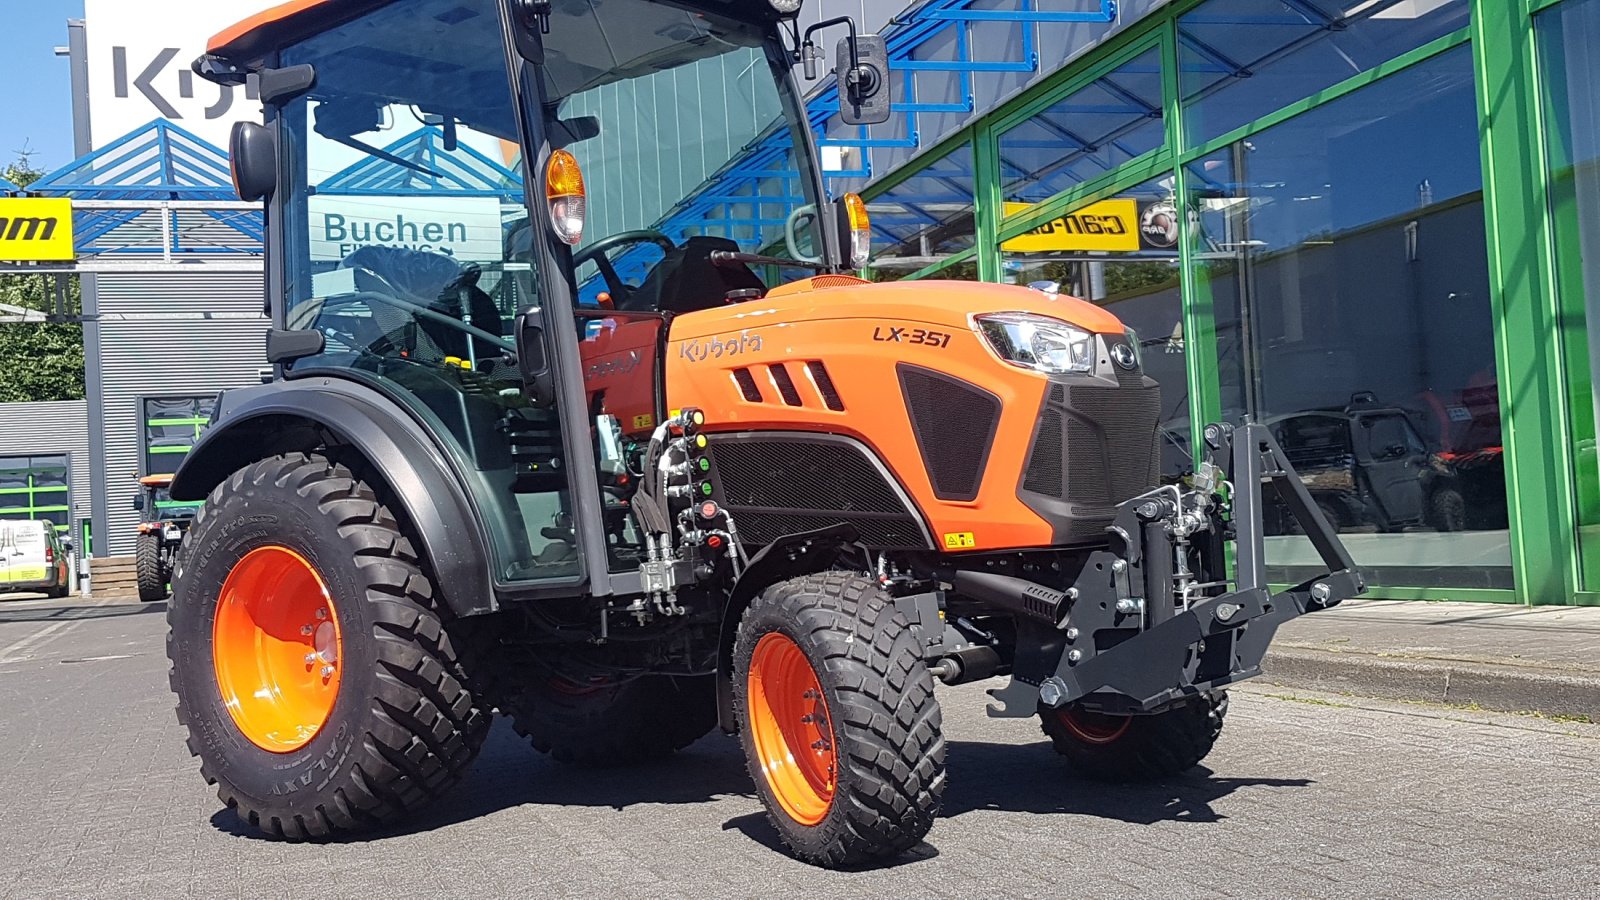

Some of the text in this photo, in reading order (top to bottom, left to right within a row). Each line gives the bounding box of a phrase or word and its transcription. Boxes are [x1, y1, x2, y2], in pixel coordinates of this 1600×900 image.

[324, 213, 468, 242] Buchen
[680, 329, 763, 362] Kubota
[873, 326, 952, 349] LX-351
